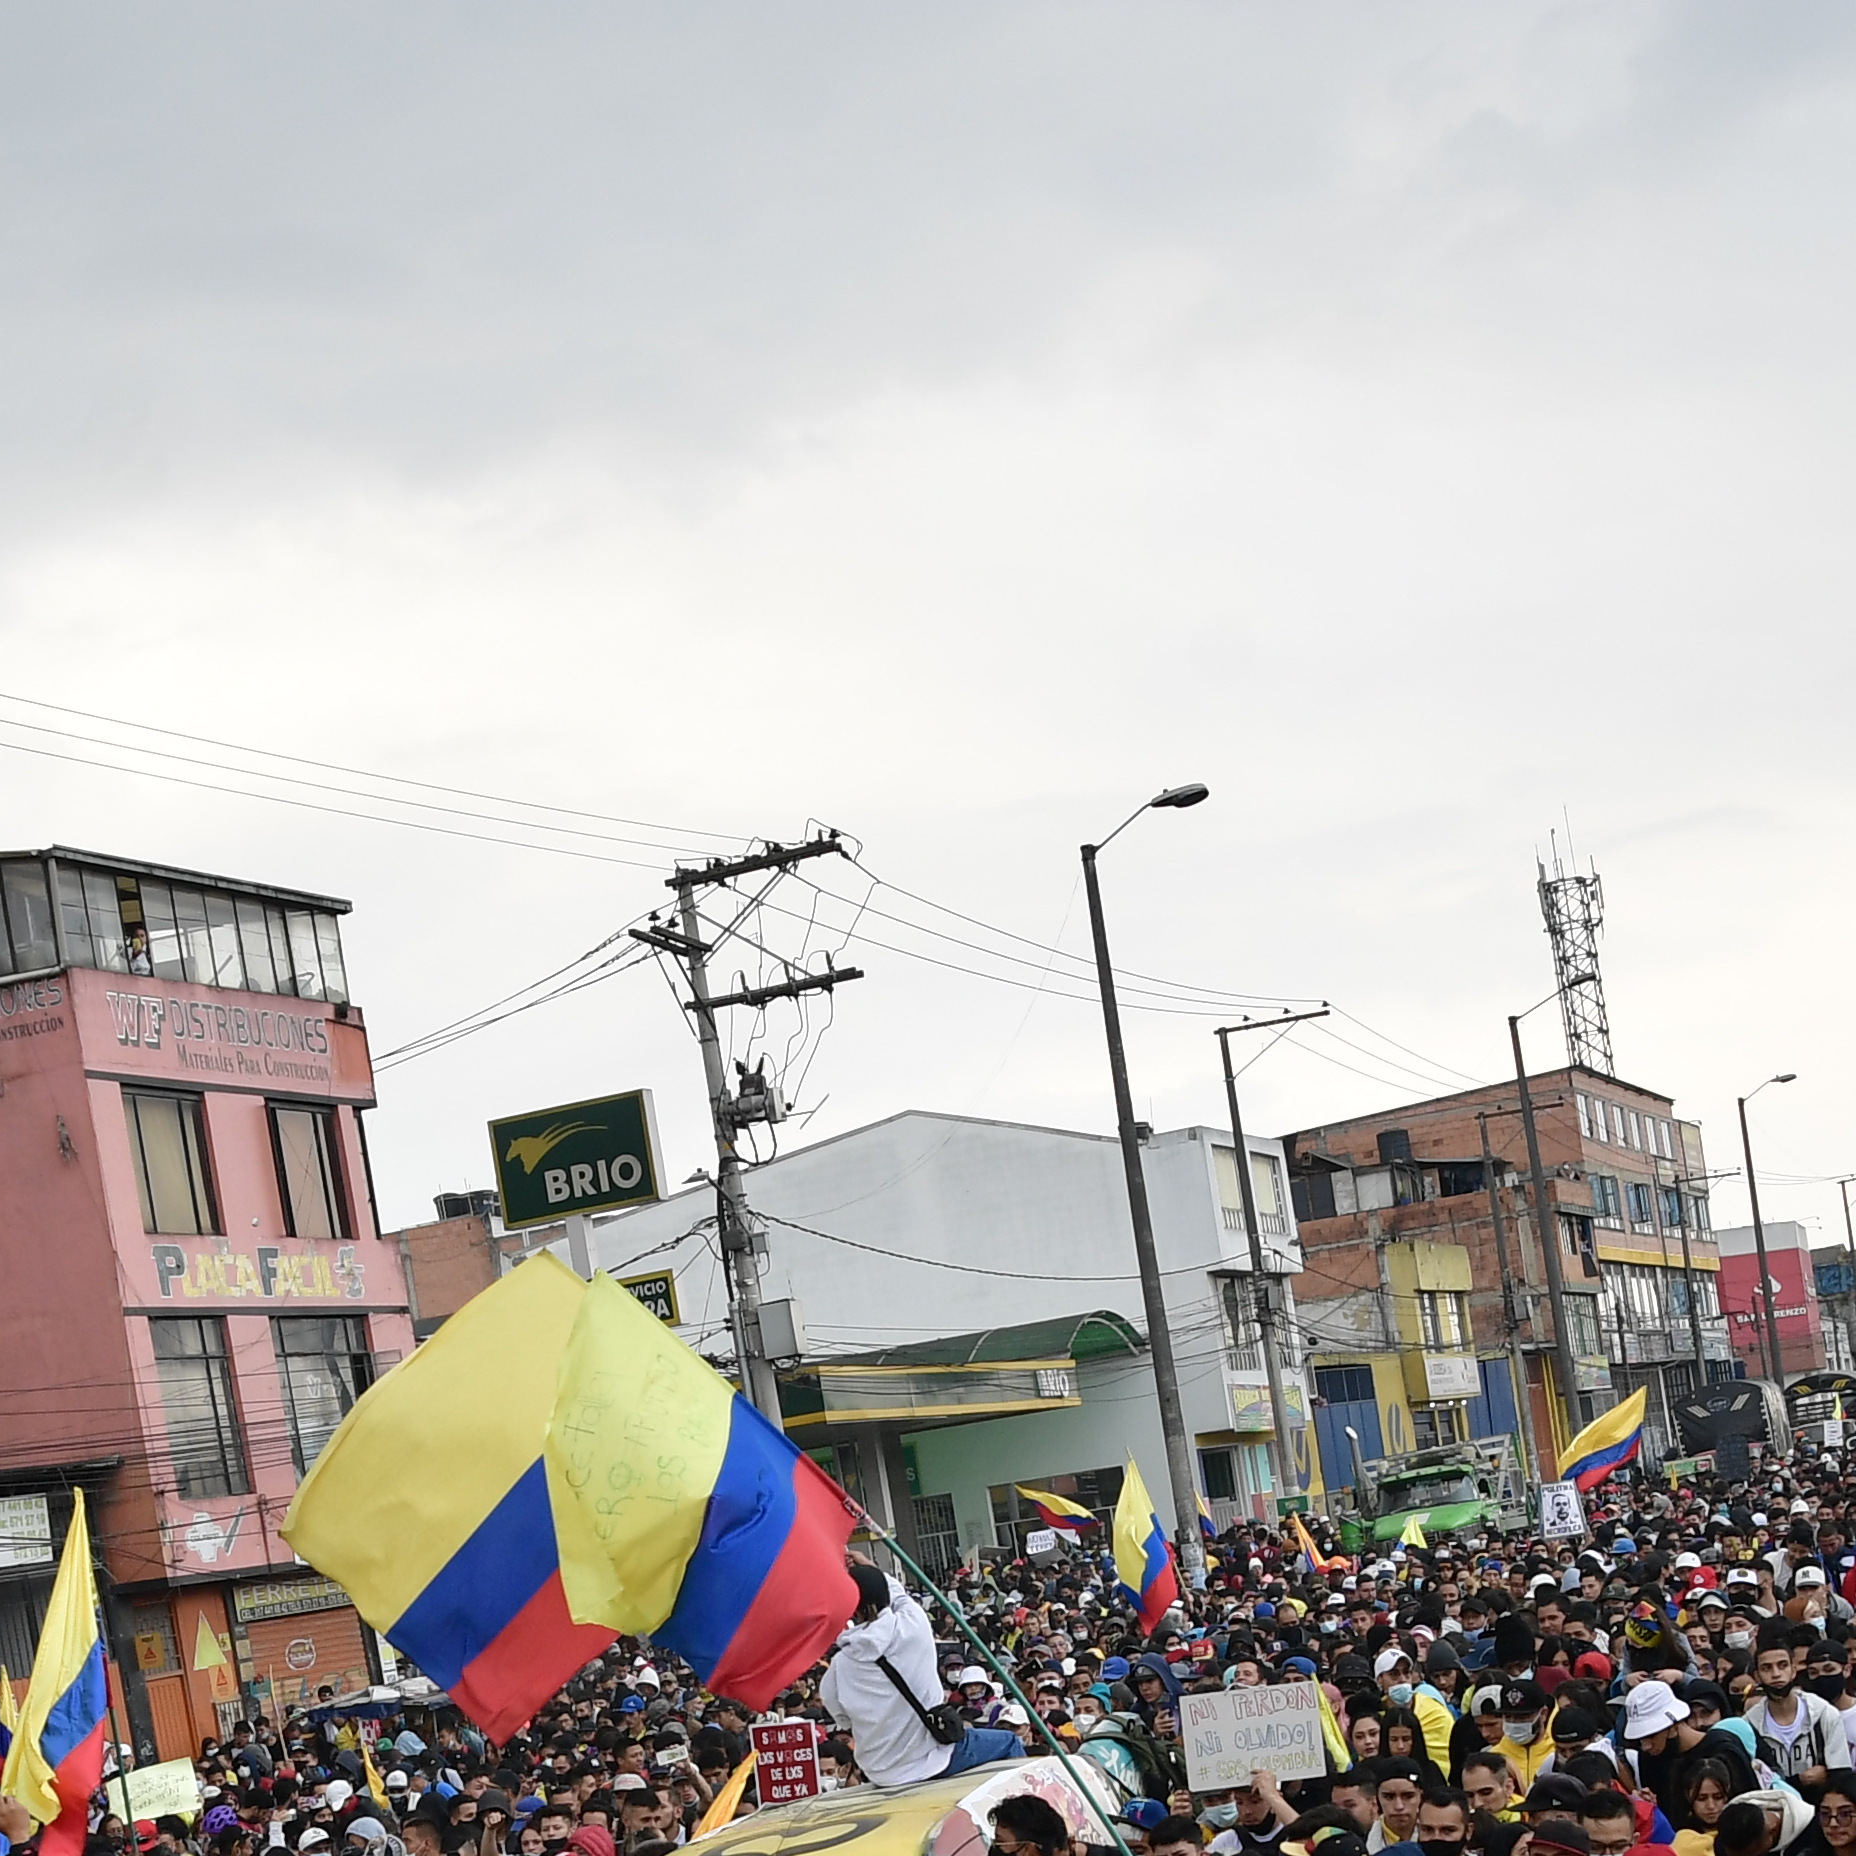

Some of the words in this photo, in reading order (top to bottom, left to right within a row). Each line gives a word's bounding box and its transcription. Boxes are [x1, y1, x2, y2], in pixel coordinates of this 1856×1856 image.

[105, 990, 165, 1049] WF
[169, 997, 331, 1056] DISTRIBUCIONES
[544, 1153, 643, 1204] BRIO
[627, 1280, 667, 1298] VICIO
[239, 1576, 344, 1606] FERRETE
[1232, 1683, 1317, 1720] PERDON
[770, 1767, 783, 1781] DE
[785, 1765, 803, 1780] LXS
[771, 1784, 792, 1799] QUE
